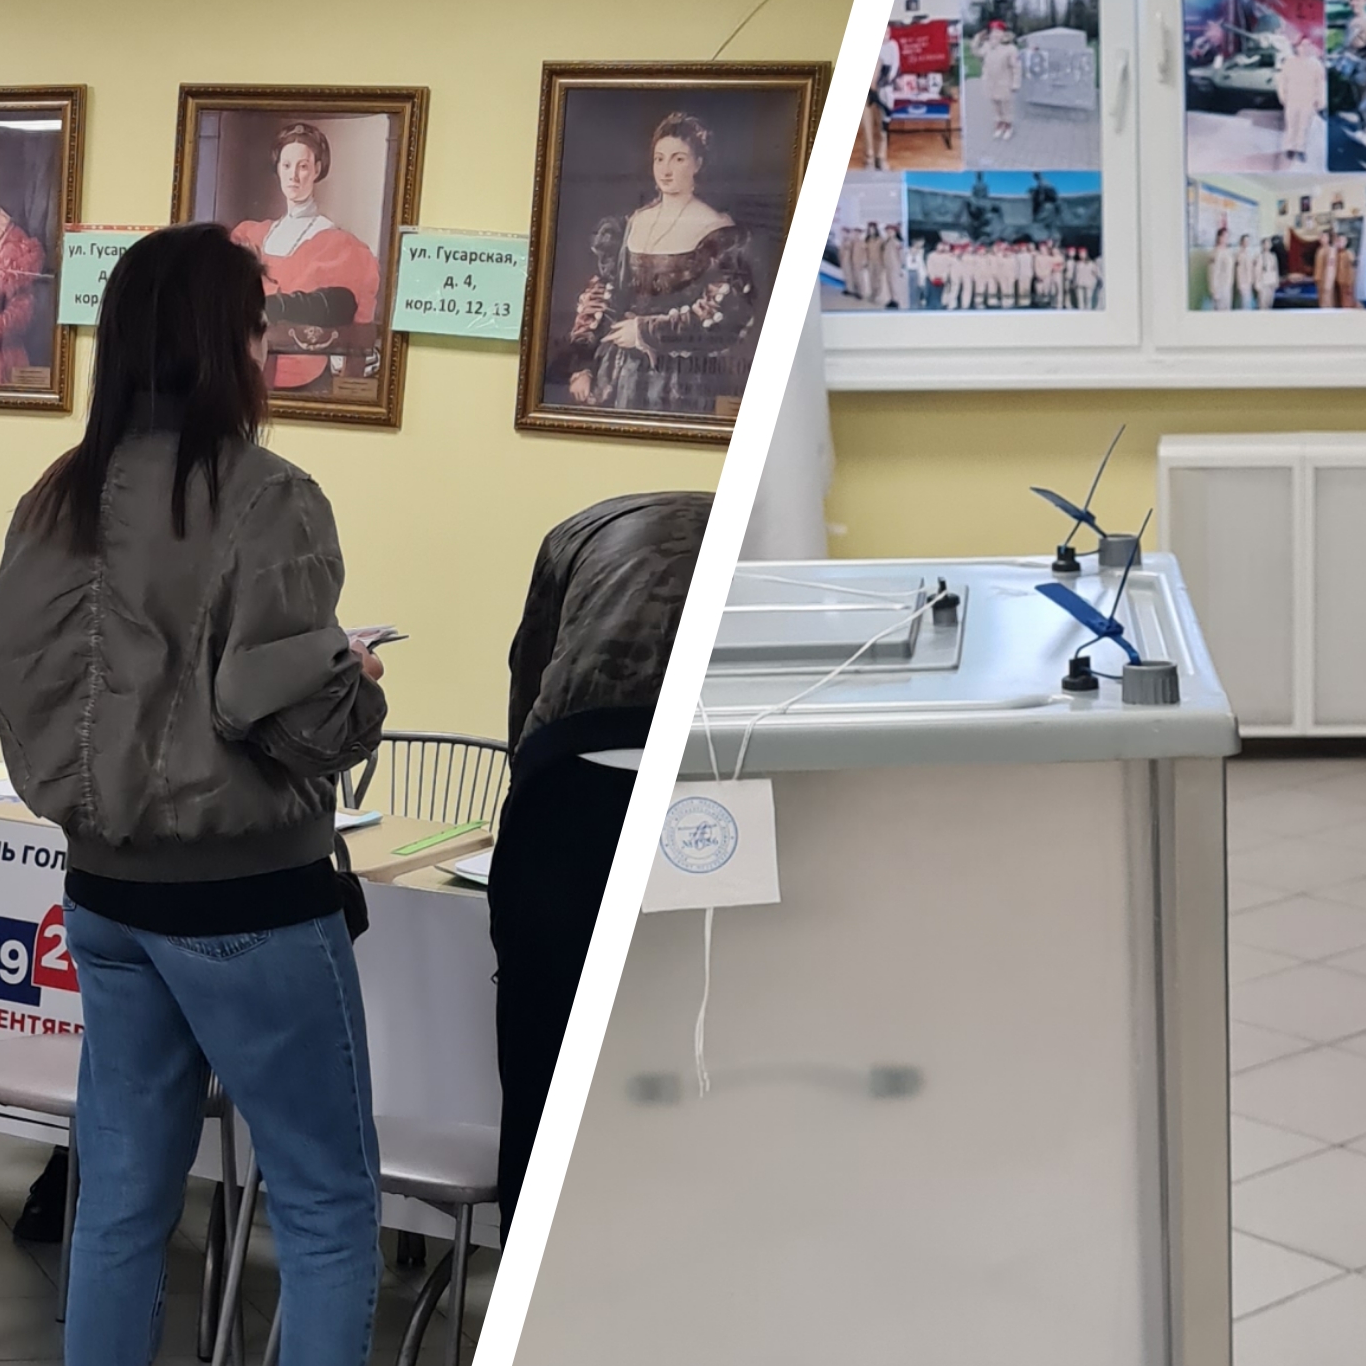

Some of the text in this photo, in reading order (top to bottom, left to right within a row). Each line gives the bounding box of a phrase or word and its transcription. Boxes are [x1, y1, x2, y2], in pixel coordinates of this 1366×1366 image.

[68, 242, 128, 259] ул. Гусар
[409, 245, 517, 267] ул. Гусарская,
[98, 270, 108, 283] д
[443, 274, 477, 290] д. 4,
[75, 293, 99, 307] кор
[465, 300, 487, 317] 12,
[493, 302, 511, 317] 13
[21, 845, 67, 871] ГОЛ
[41, 923, 78, 971] 2
